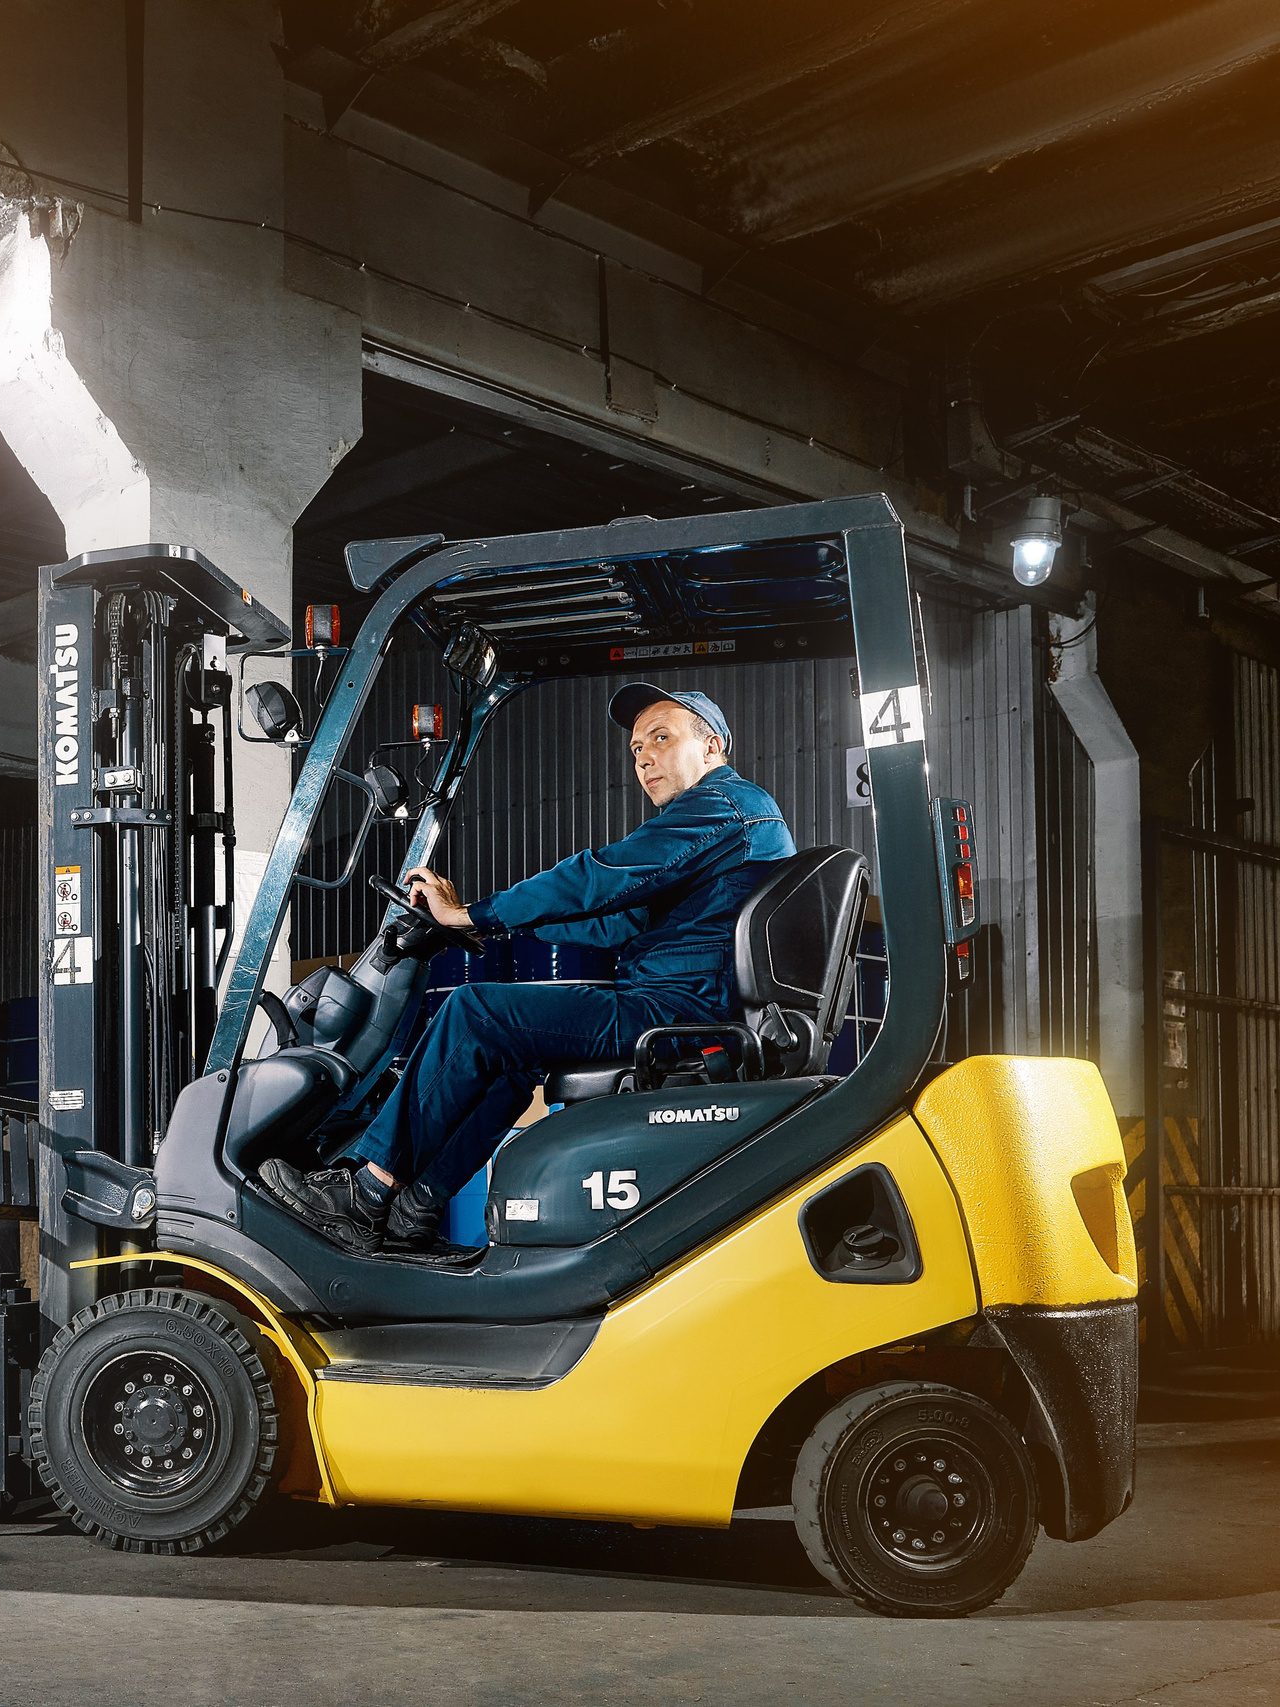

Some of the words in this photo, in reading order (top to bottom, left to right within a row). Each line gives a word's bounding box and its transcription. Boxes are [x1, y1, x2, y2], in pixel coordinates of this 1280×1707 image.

[50, 623, 79, 786] KOMATSU
[869, 688, 911, 743] 4
[51, 937, 81, 984] 4
[648, 1104, 740, 1124] KOMATSU
[582, 1170, 640, 1210] 15
[165, 1319, 206, 1346] 6.50
[217, 1355, 236, 1378] 10
[60, 1457, 141, 1528] ACHIEVER
